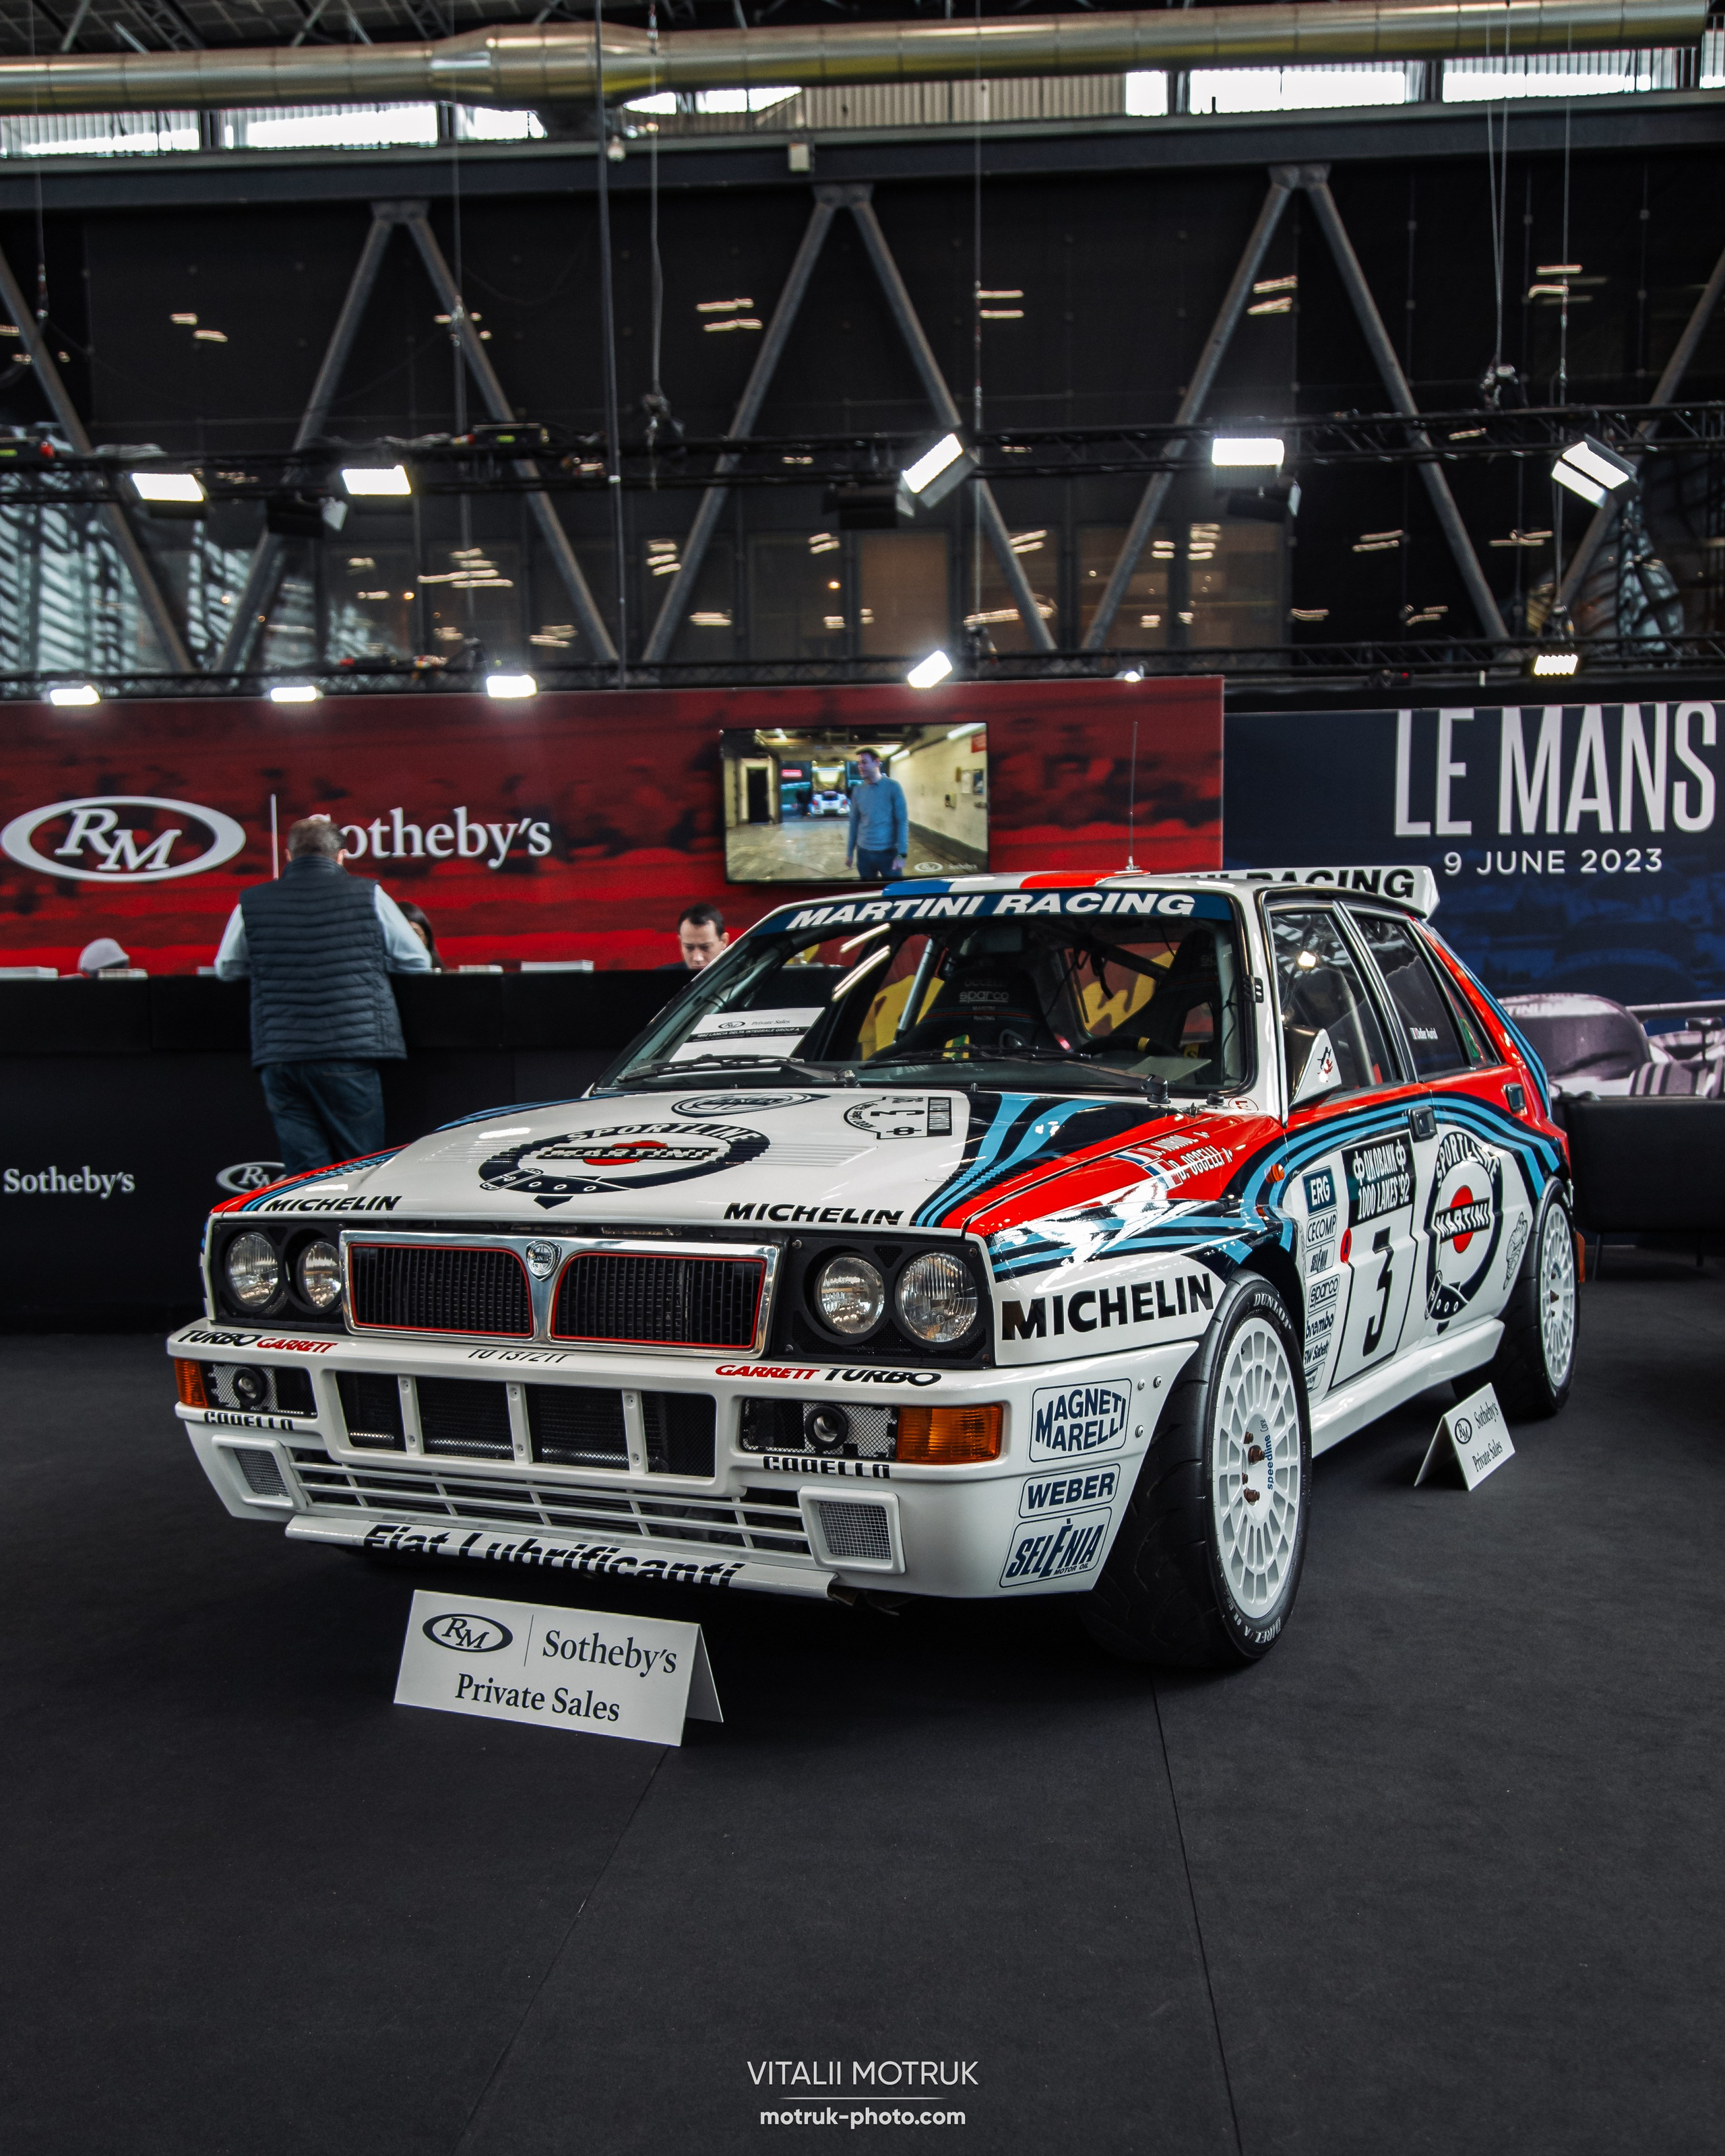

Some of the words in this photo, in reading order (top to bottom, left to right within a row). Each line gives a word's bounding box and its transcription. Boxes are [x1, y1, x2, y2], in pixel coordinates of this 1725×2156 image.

[1394, 707, 1474, 837] LE
[1498, 701, 1717, 835] MANS
[55, 808, 182, 871] RM
[309, 806, 553, 869] otheby's
[1443, 851, 1462, 876] 9
[1476, 850, 1565, 875] JUNE
[1580, 848, 1662, 875] 2023
[785, 895, 986, 932] MARTINI
[992, 892, 1196, 916] RACING
[959, 990, 1009, 1003] sparco
[566, 1122, 762, 1141] SPORTLINE
[544, 1147, 713, 1159] MARTINI
[1363, 1143, 1398, 1181] OKOBANK
[3, 1166, 135, 1200] Sotheby's
[1310, 1175, 1330, 1207] ERG
[1358, 1184, 1377, 1220] 1000
[1377, 1176, 1398, 1213] LAKES
[1398, 1172, 1410, 1205] '92
[264, 1195, 403, 1212] MICHELIN
[723, 1203, 905, 1226] MICHELIN
[1435, 1203, 1489, 1238] MARTINI
[1307, 1214, 1337, 1243] CECOMP
[1002, 1273, 1214, 1340] MICHELIN
[1309, 1277, 1339, 1308] sparco
[1362, 1226, 1394, 1357] 3
[1253, 1292, 1292, 1330] DUNLOP
[1306, 1310, 1334, 1339] brembo
[177, 1330, 263, 1347] TURBO
[256, 1337, 339, 1353] GARRETT
[715, 1364, 821, 1380] GARRETT
[824, 1368, 942, 1387] TURBO
[1035, 1388, 1127, 1438] MAGNETI
[1035, 1407, 1127, 1452] MARELLI
[1473, 1401, 1499, 1430] Sotheby's
[763, 1455, 891, 1479] CARELLO
[1264, 1434, 1274, 1490] speedline
[1472, 1452, 1491, 1473] Private
[1488, 1439, 1503, 1459] Sales
[1028, 1471, 1116, 1510] WEBER
[364, 1524, 451, 1554] Fiat
[458, 1532, 746, 1587] Lubrificanti
[1053, 1564, 1077, 1576] MOTOR
[1079, 1562, 1090, 1571] OIL
[441, 1618, 490, 1649] RM
[542, 1629, 678, 1678] Sotheby's
[454, 1673, 546, 1711] Private
[551, 1687, 621, 1722] Sales
